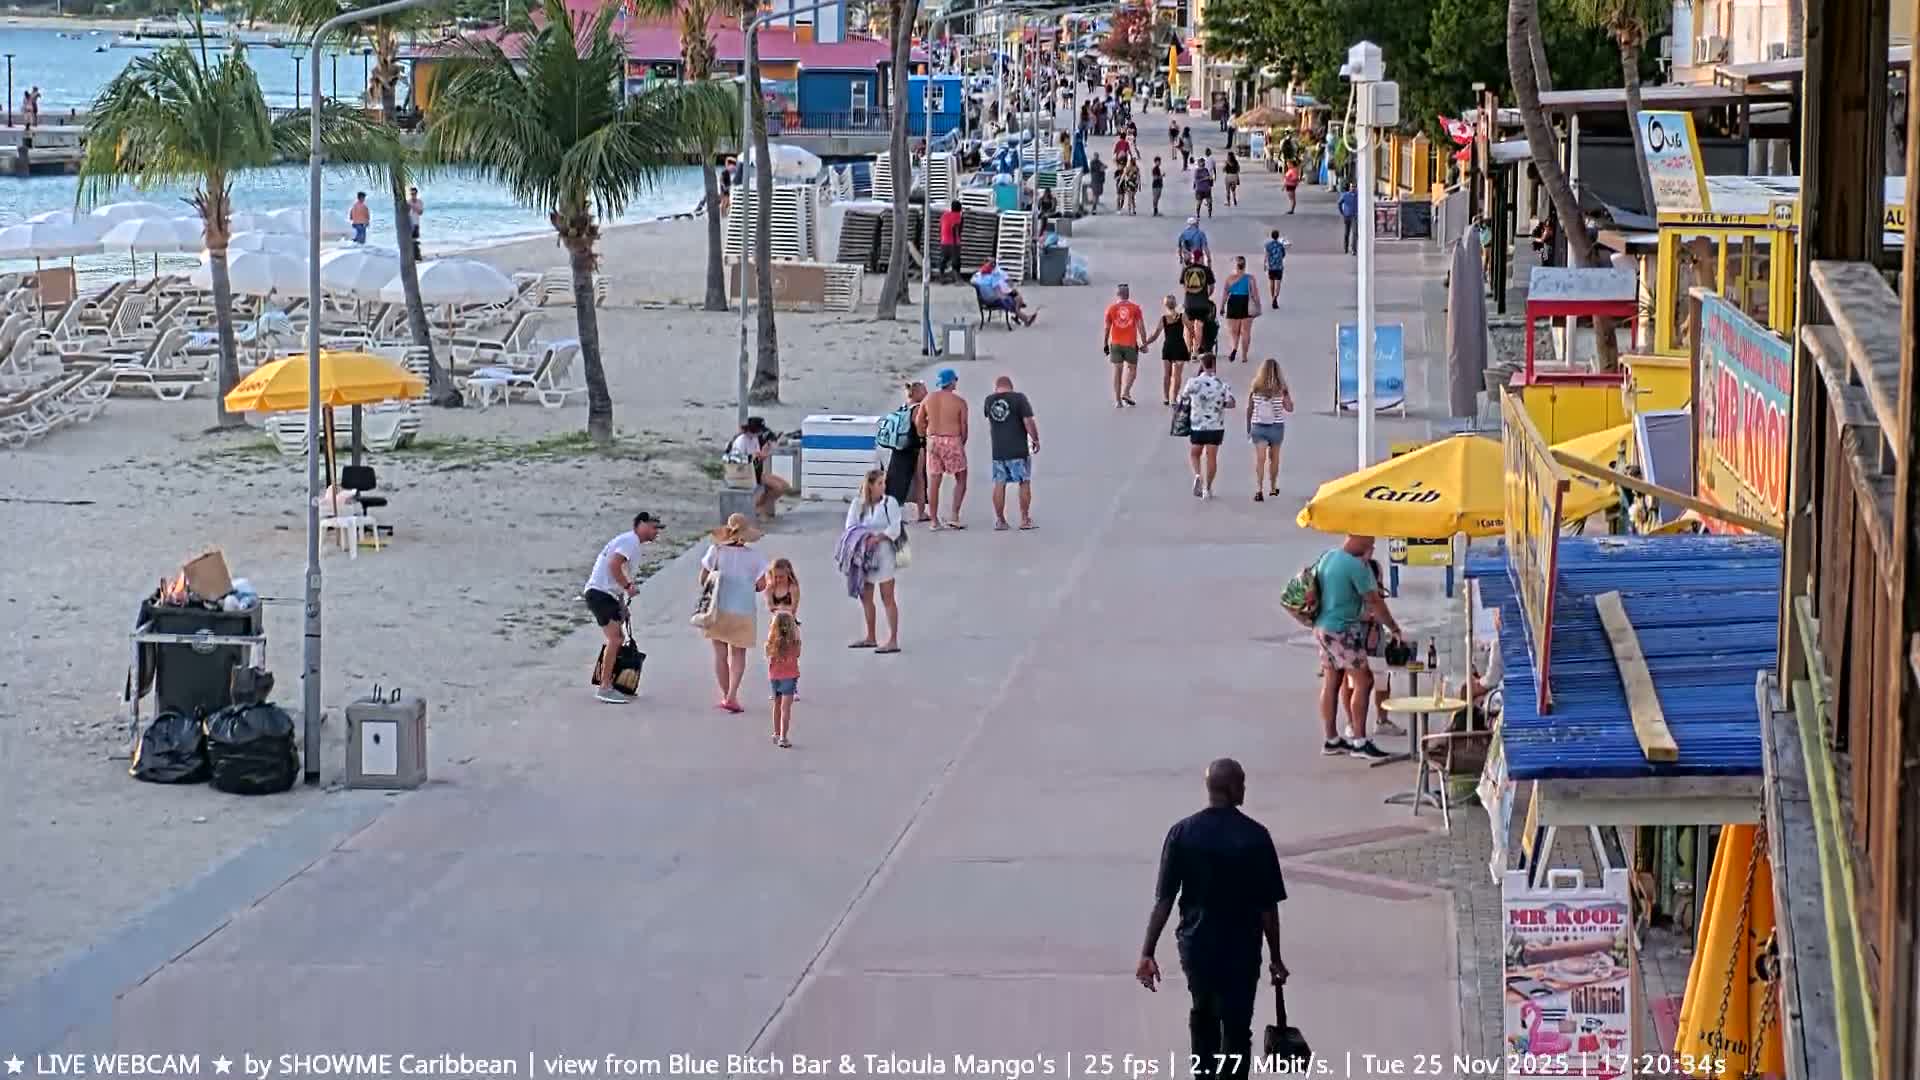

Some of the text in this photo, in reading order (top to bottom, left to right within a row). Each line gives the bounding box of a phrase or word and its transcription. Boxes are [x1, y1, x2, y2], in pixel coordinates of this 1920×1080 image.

[1691, 214, 1716, 223] FREE
[1717, 362, 1740, 480] MR
[1363, 481, 1441, 503] Carib
[1510, 909, 1623, 924] MR KOOL
